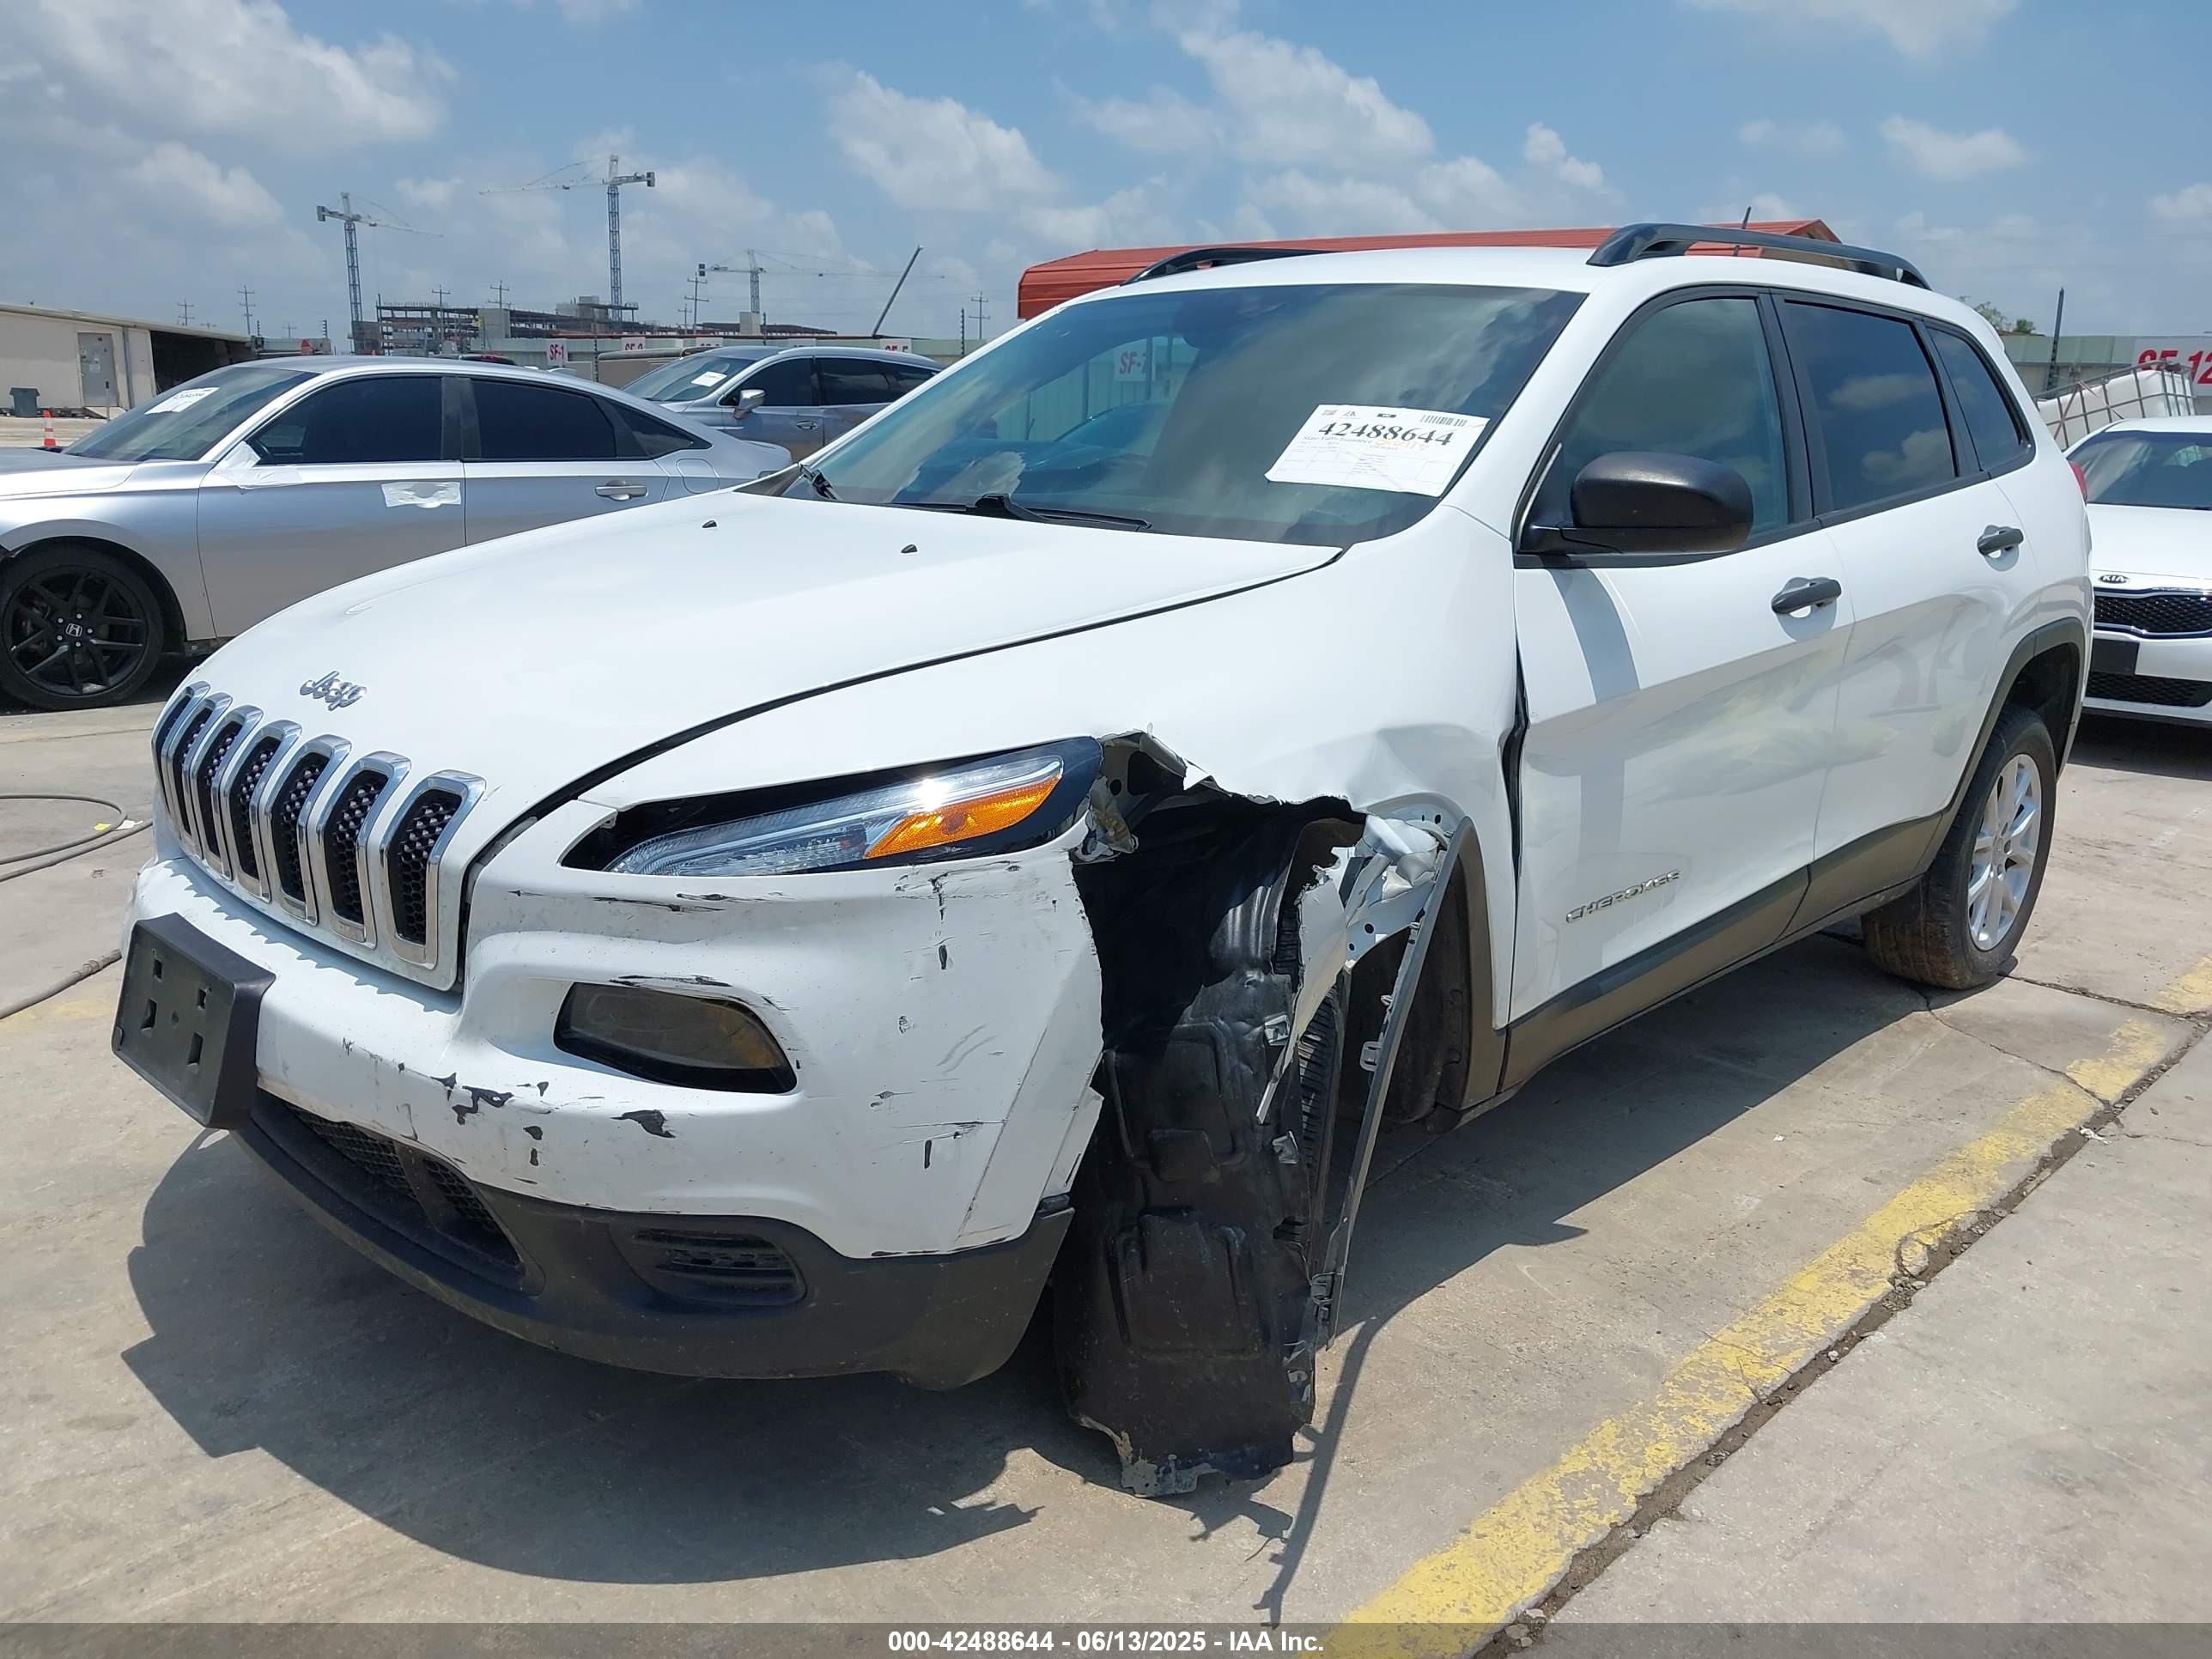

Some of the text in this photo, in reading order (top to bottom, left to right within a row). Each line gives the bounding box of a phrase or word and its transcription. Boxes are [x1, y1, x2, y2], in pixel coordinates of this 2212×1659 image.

[550, 344, 564, 361] SF-1
[1318, 422, 1454, 446] 42488644
[300, 671, 367, 711] Jeep
[1566, 868, 1680, 923] CHEROKEE
